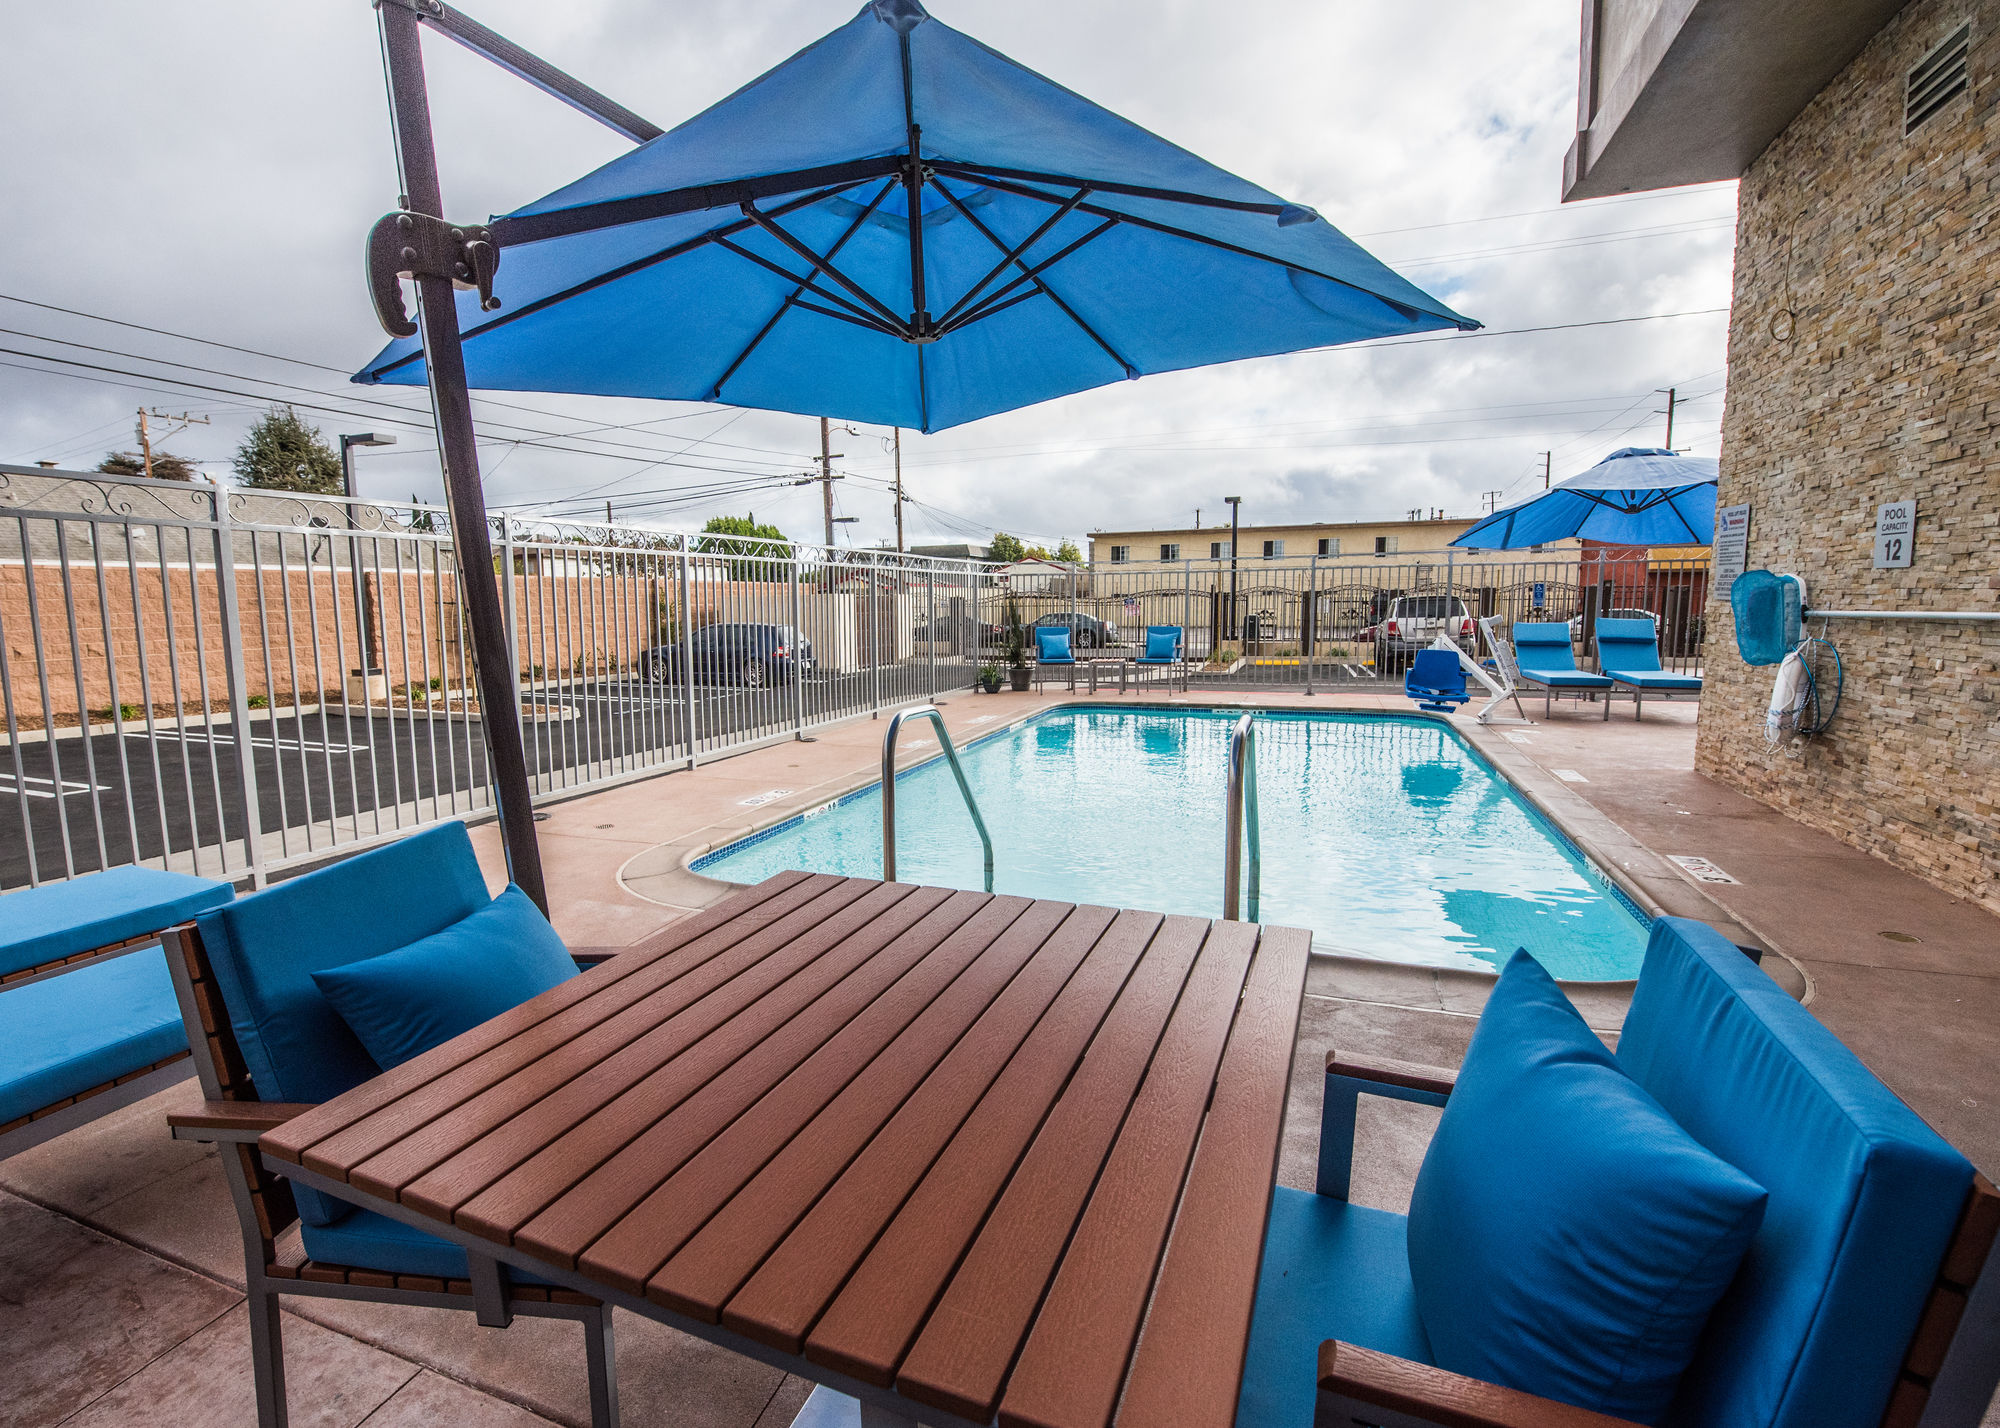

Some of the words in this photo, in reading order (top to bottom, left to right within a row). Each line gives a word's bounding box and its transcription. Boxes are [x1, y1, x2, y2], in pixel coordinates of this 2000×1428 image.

[1885, 508, 1907, 520] POOL
[1882, 522, 1908, 531] CAPACITY
[1885, 539, 1902, 560] 12
